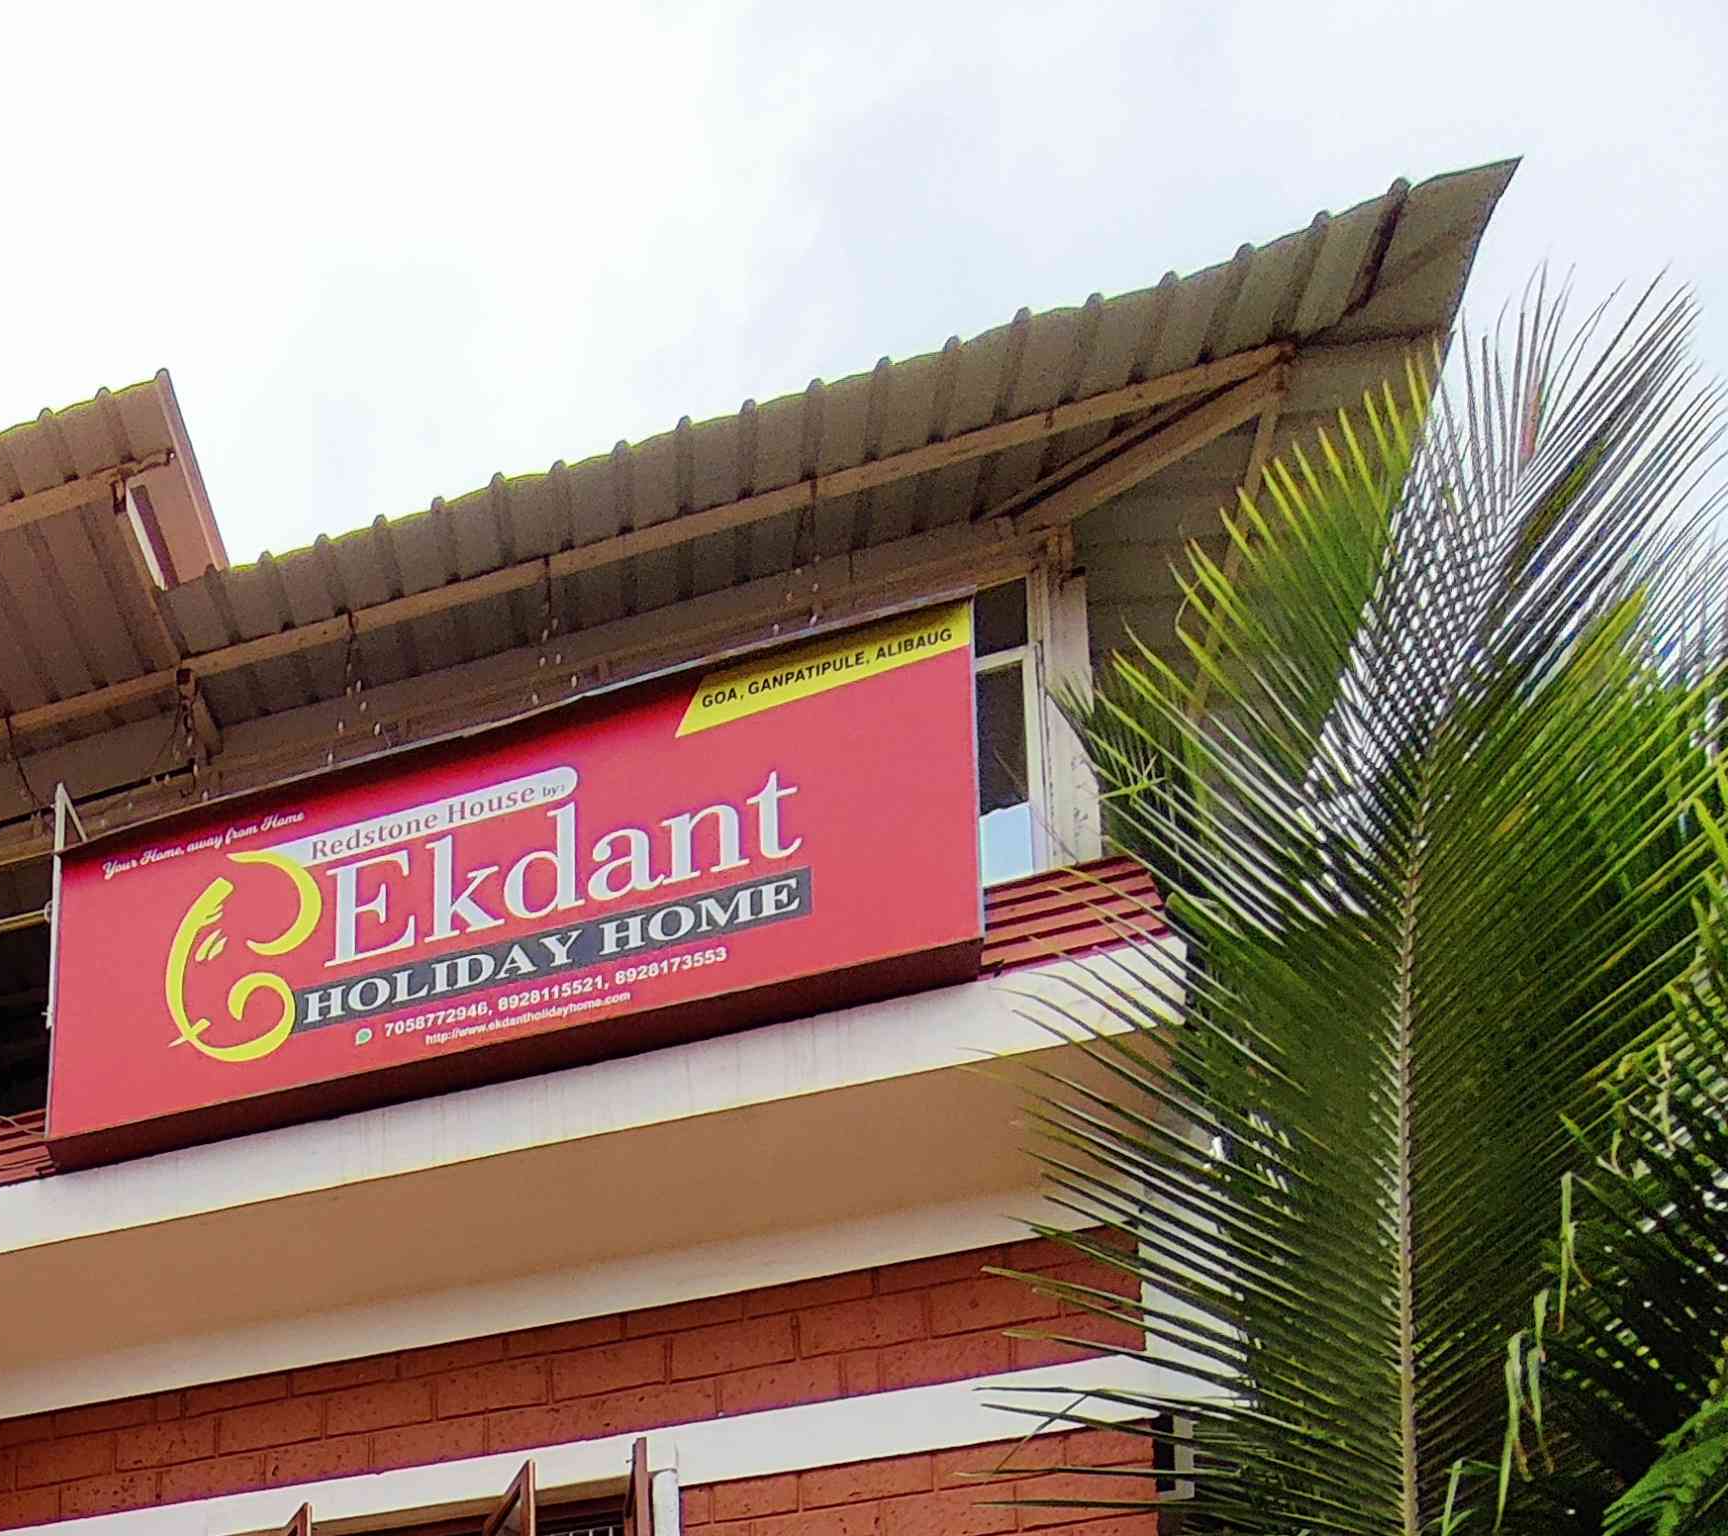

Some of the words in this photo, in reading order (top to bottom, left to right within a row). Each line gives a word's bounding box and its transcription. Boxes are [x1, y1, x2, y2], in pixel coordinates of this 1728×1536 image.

[701, 687, 744, 709] GOA,
[747, 651, 870, 695] GANPATIPULE,
[875, 627, 953, 662] ALIBAUG
[102, 860, 138, 880] Your
[186, 834, 223, 849] away
[224, 825, 259, 845] from
[260, 811, 305, 832] Home
[311, 811, 438, 860] Redstone
[447, 786, 536, 824] House
[323, 770, 803, 969] Ekdant
[303, 929, 583, 1025] HOLIDAY
[599, 877, 801, 956] HOME
[384, 1001, 493, 1037] 7058772946,
[498, 975, 609, 1011] 8928115521,
[614, 947, 728, 985] 8928173553
